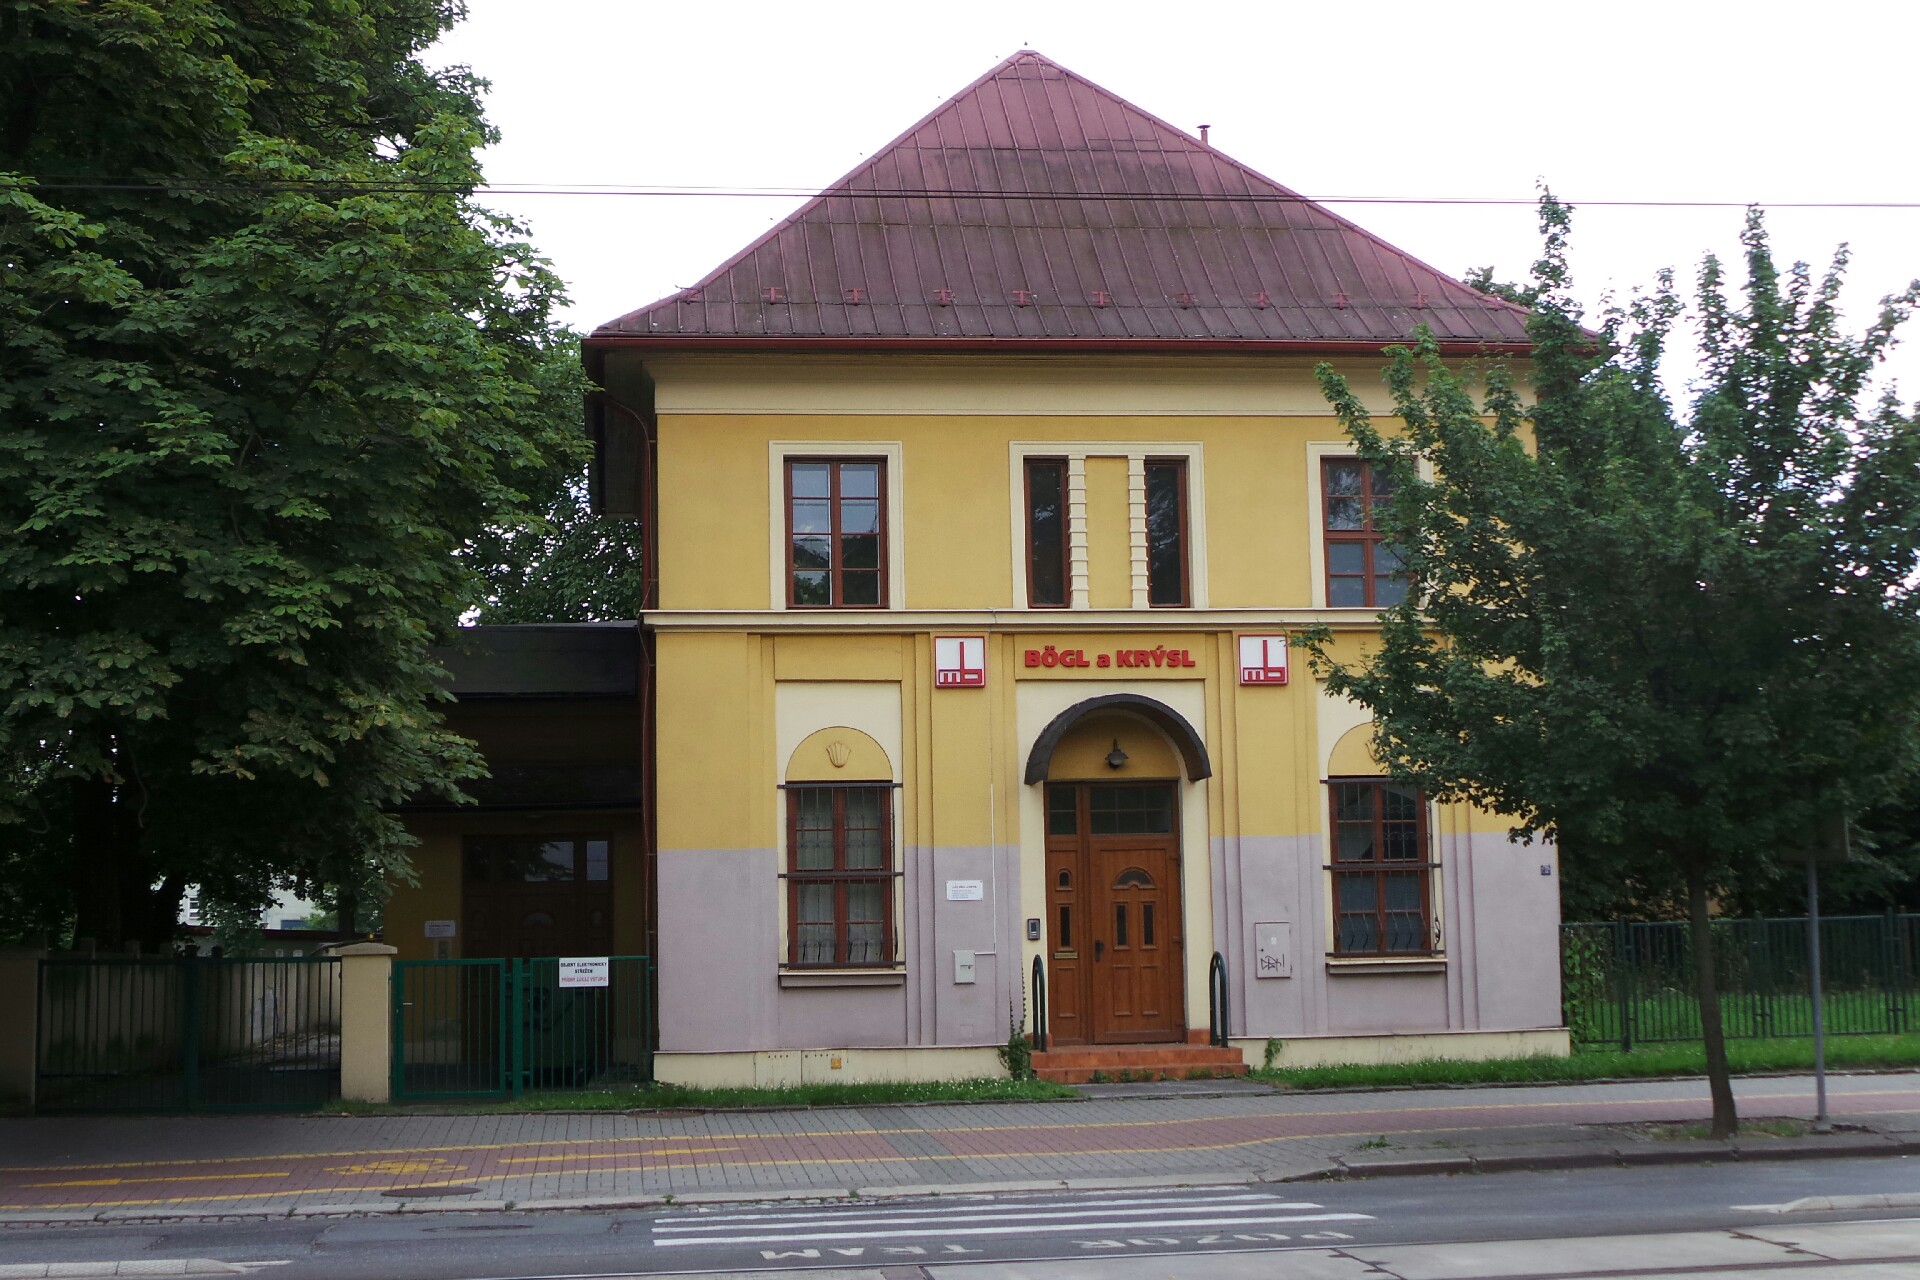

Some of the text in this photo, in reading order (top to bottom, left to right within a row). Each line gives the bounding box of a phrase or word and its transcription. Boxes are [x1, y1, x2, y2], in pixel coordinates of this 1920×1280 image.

[1024, 645, 1196, 668] BÖGL a KRÝSL
[760, 1244, 984, 1260] TRAM
